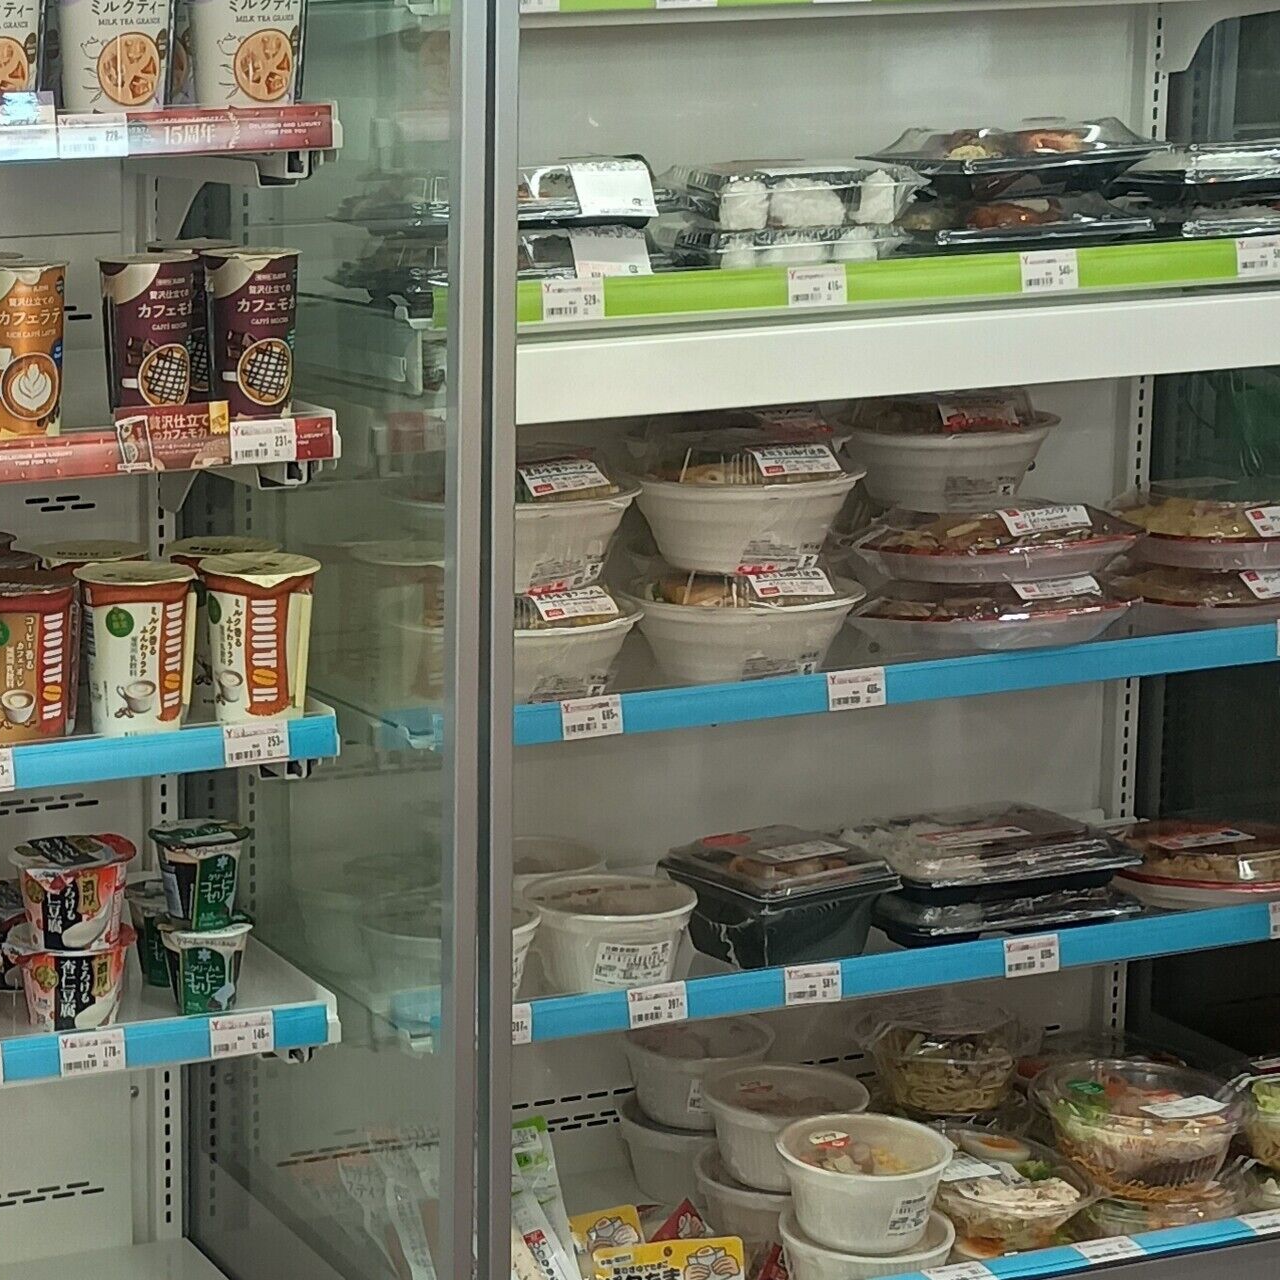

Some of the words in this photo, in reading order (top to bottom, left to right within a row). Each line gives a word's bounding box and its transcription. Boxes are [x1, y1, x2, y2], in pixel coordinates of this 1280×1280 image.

[163, 124, 216, 145] 15周年
[60, 960, 77, 1019] 杏仁豆腐
